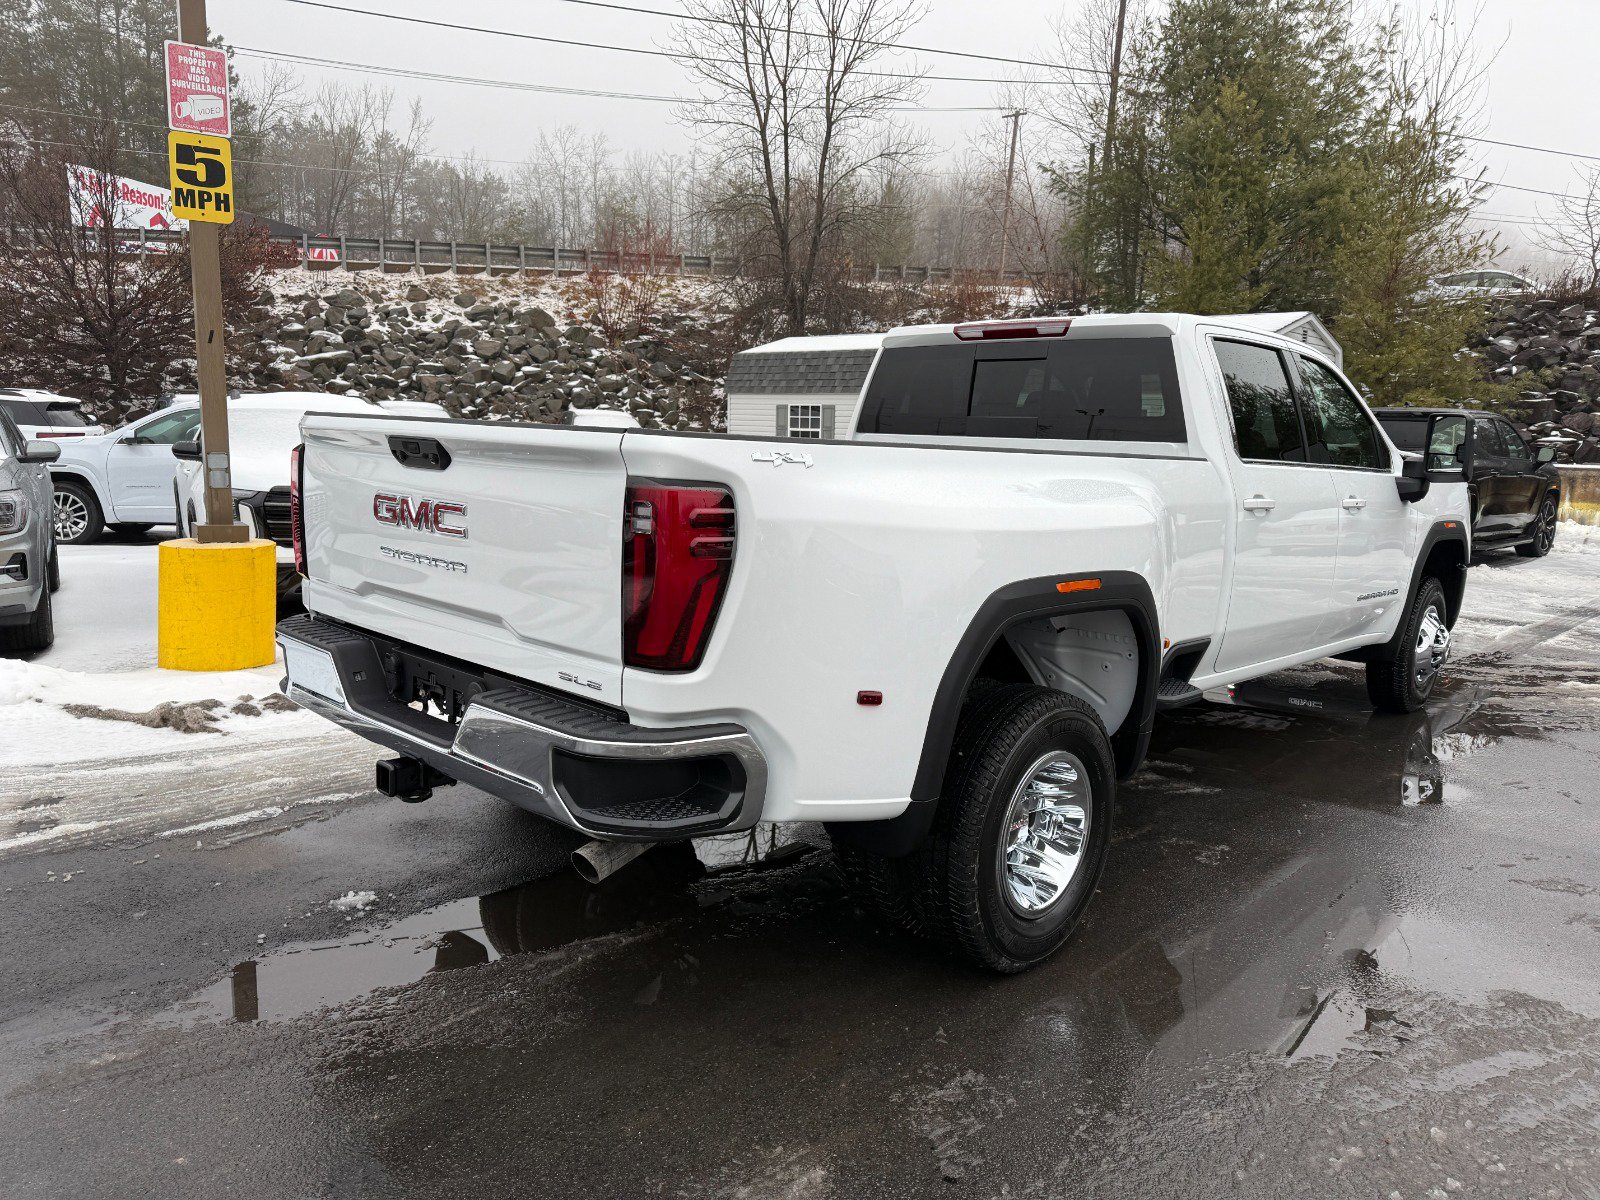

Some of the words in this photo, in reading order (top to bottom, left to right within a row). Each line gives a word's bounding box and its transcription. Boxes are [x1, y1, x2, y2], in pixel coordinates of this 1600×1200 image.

[178, 55, 217, 69] PROPERTY
[189, 49, 206, 59] THIS
[190, 65, 206, 75] HAS
[187, 73, 210, 84] VIDEO
[171, 79, 226, 95] SURVEILLANCE
[197, 107, 221, 116] VIDEO
[176, 143, 226, 189] 5
[121, 182, 165, 210] Reason!
[174, 187, 231, 213] MPH
[373, 491, 469, 539] GMC
[380, 545, 468, 574] SIERRA
[1356, 591, 1387, 602] SIERRA
[1387, 588, 1399, 596] HD
[558, 671, 603, 691] SLE
